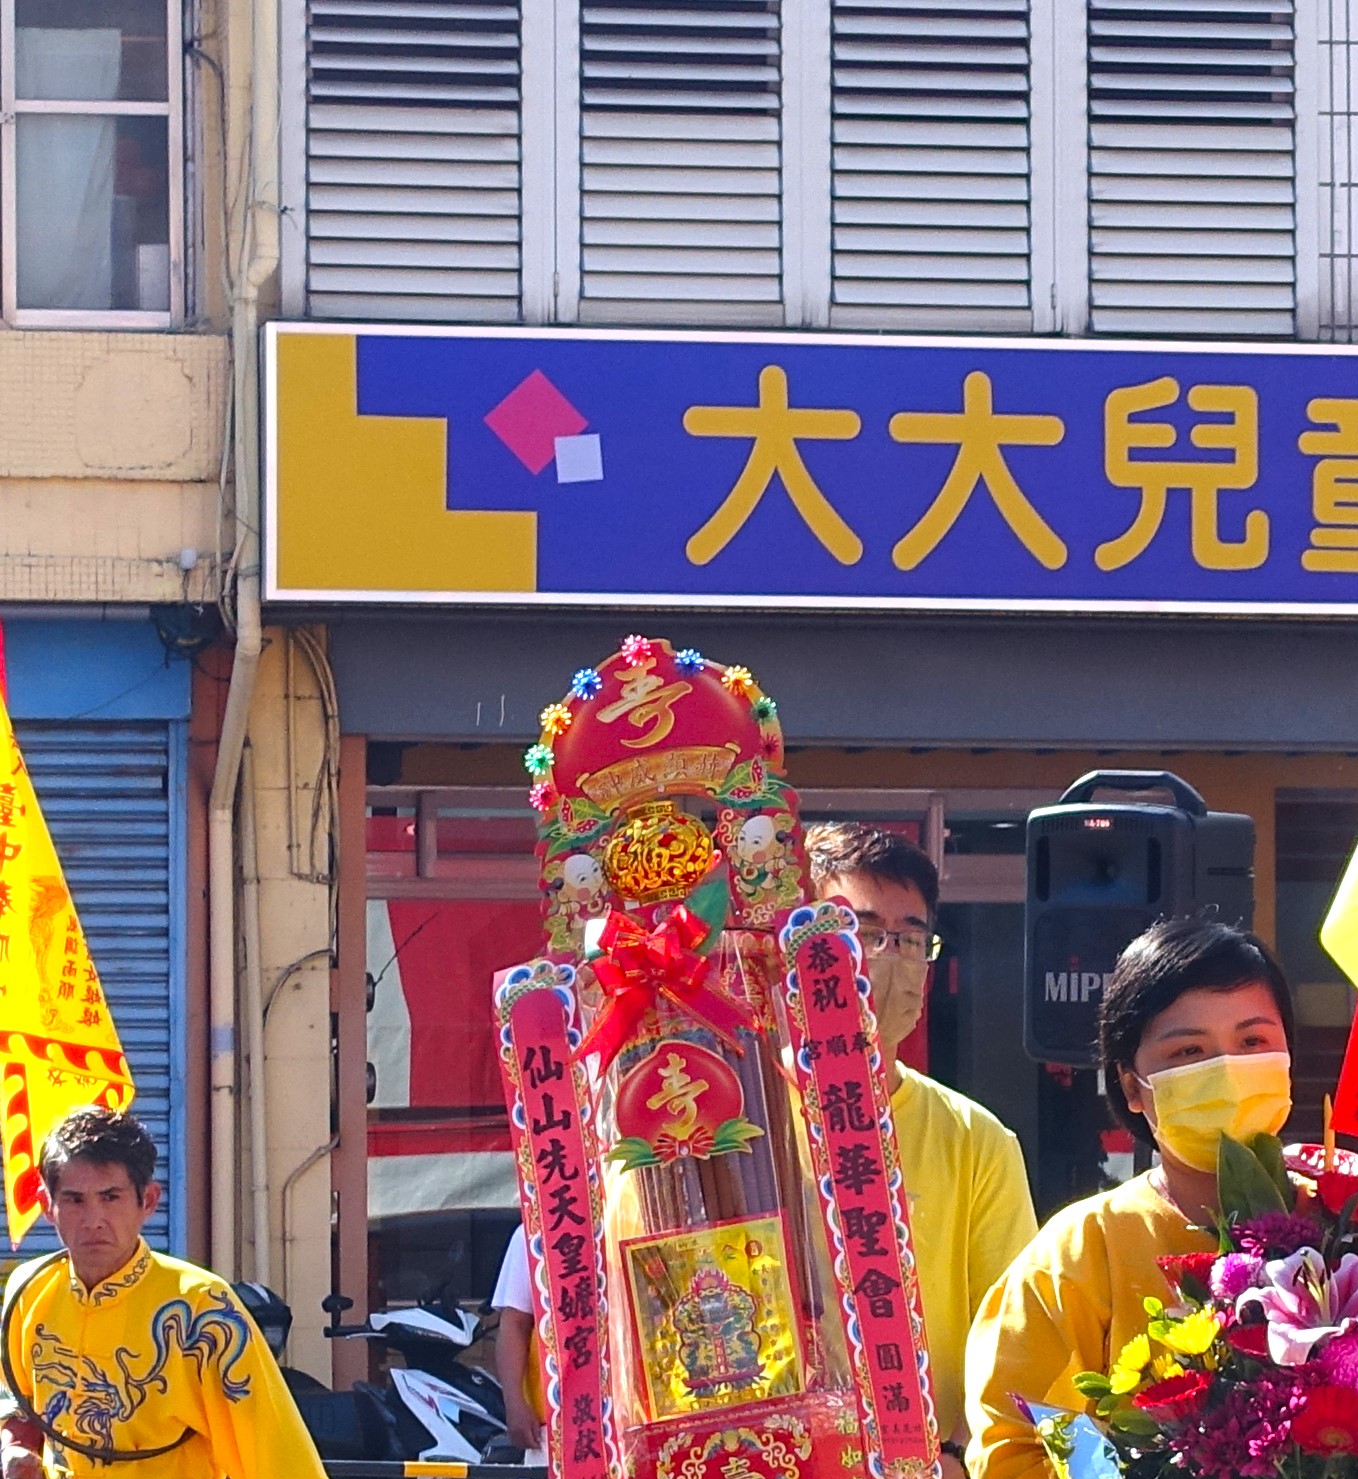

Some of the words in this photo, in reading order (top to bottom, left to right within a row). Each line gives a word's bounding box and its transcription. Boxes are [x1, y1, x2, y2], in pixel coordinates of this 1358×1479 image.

[807, 938, 848, 1013] 恭祝
[820, 1080, 901, 1319] 龍華聖會
[876, 1343, 910, 1413] 圓滿
